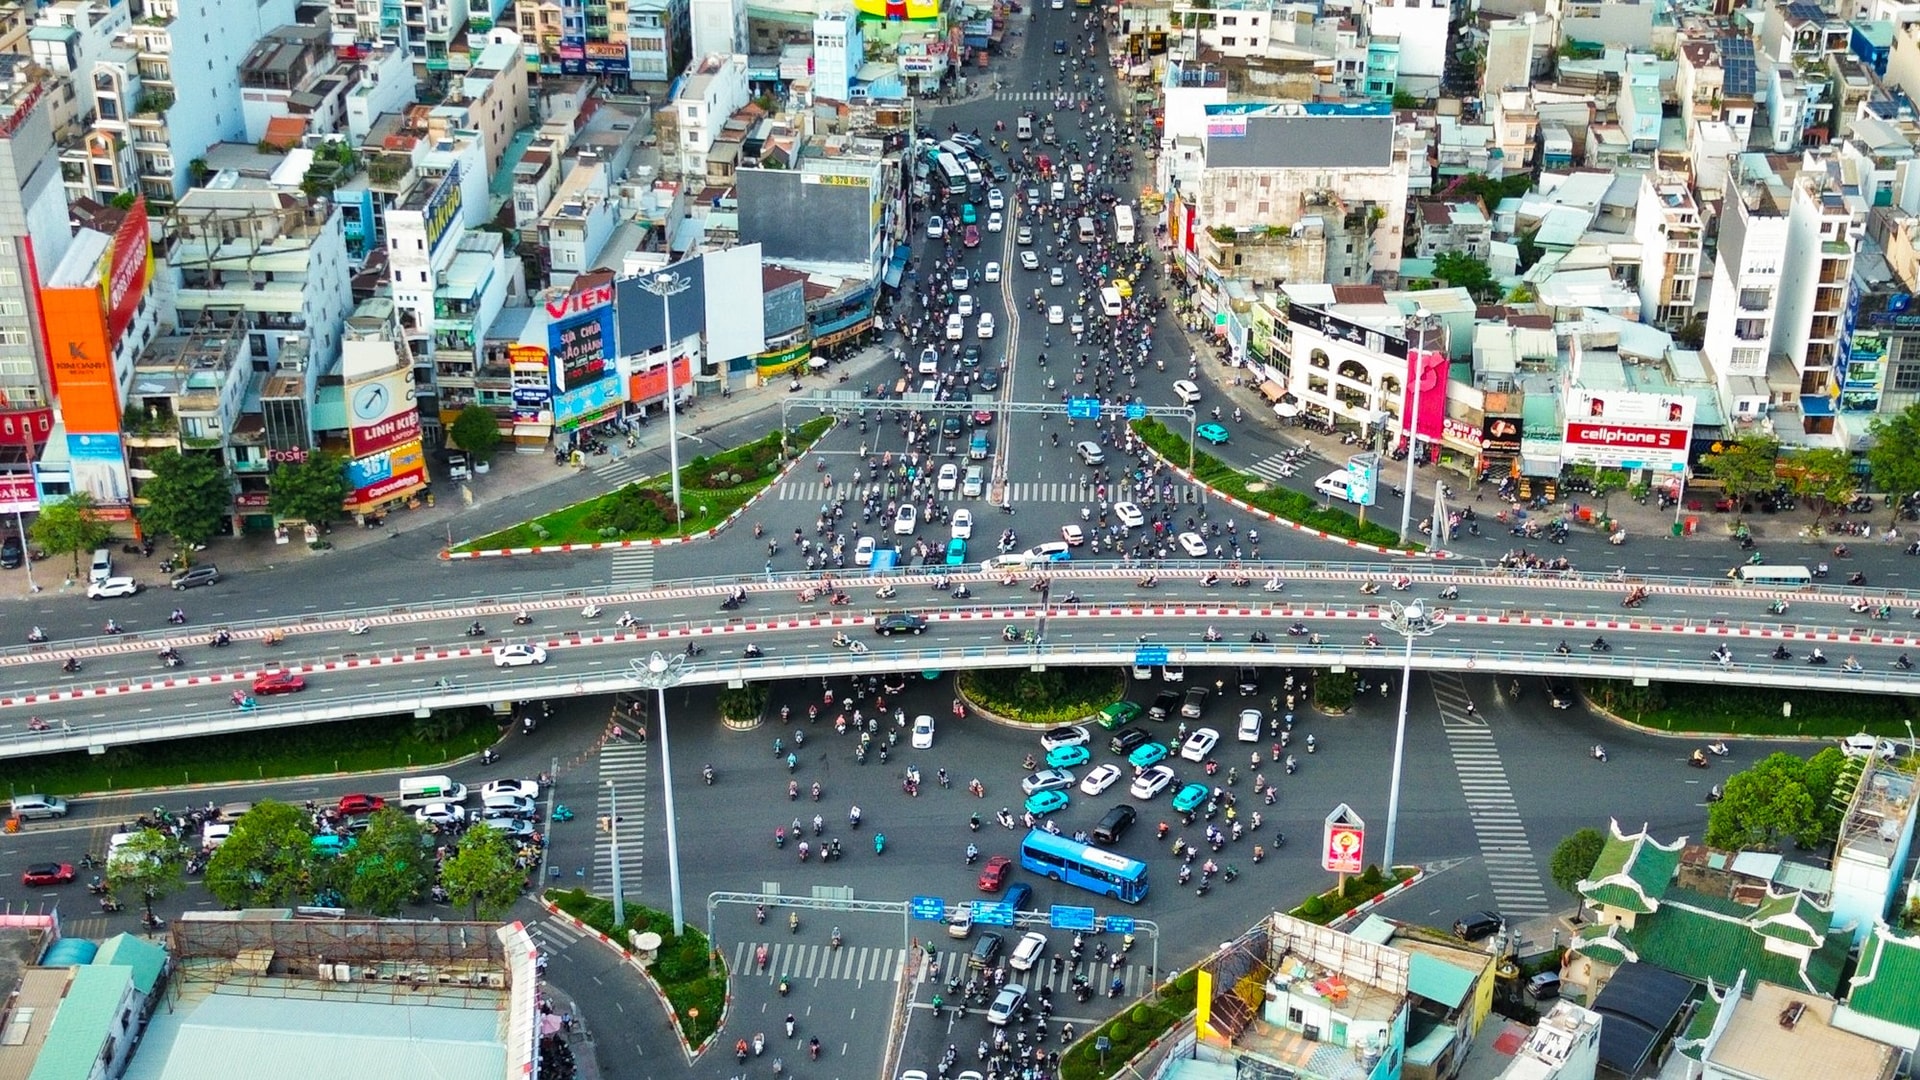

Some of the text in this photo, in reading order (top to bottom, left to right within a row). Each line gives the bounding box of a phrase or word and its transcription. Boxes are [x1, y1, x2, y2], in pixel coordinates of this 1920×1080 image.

[545, 287, 611, 318] VIỆN
[364, 421, 396, 441] LINH
[1580, 428, 1671, 446] cellphone S
[362, 454, 390, 478] 367
[0, 488, 31, 499] ANK
